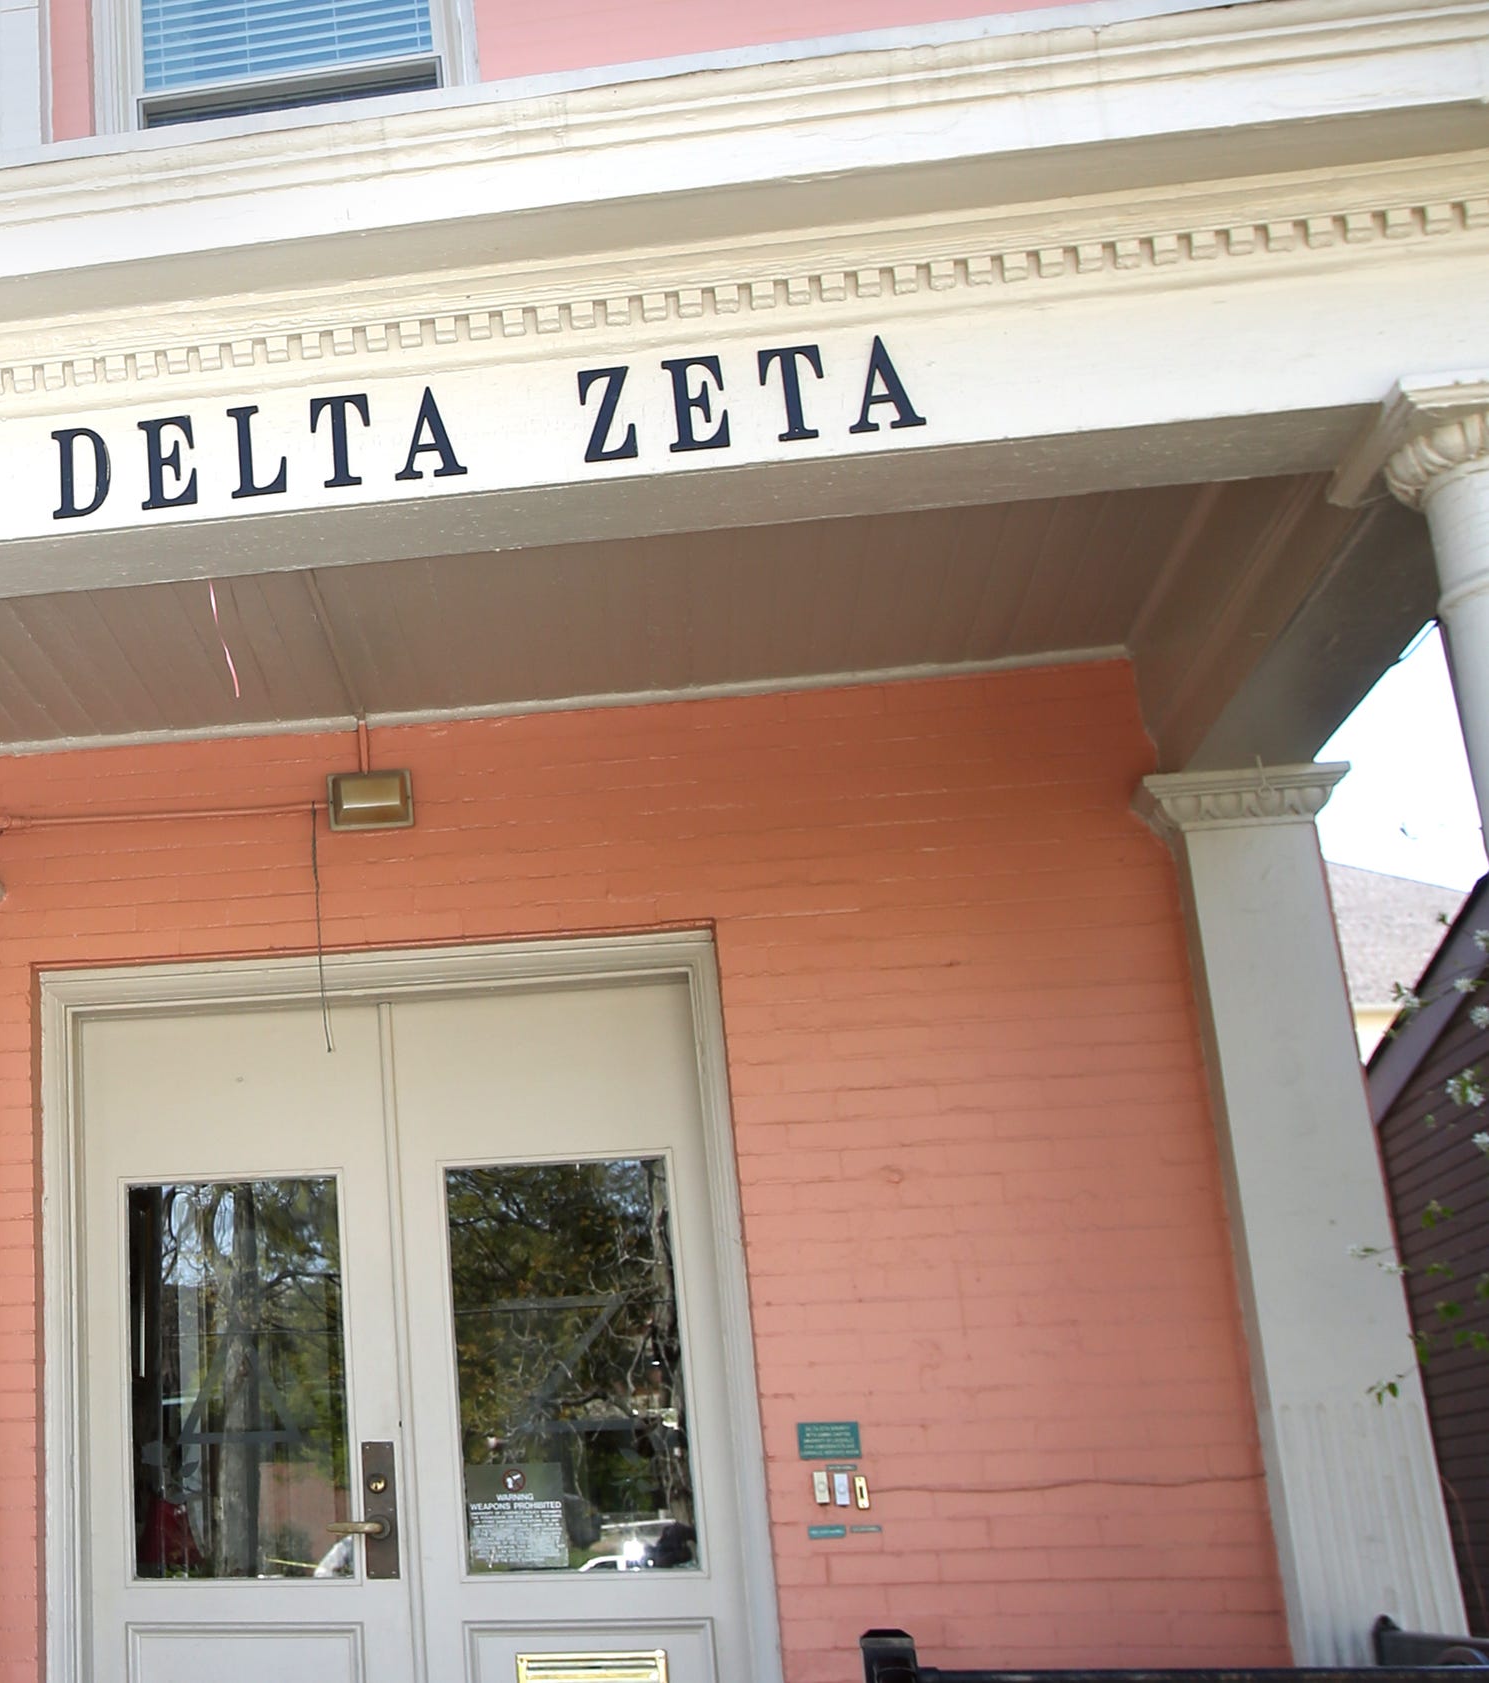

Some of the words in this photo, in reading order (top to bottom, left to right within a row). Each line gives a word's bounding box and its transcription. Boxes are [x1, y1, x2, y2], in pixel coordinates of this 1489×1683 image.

[51, 385, 467, 520] DELTA
[577, 334, 927, 463] ZETA
[496, 1493, 535, 1501] WARNING
[470, 1502, 511, 1511] WEAPONS
[513, 1501, 562, 1510] PROHIBITED
